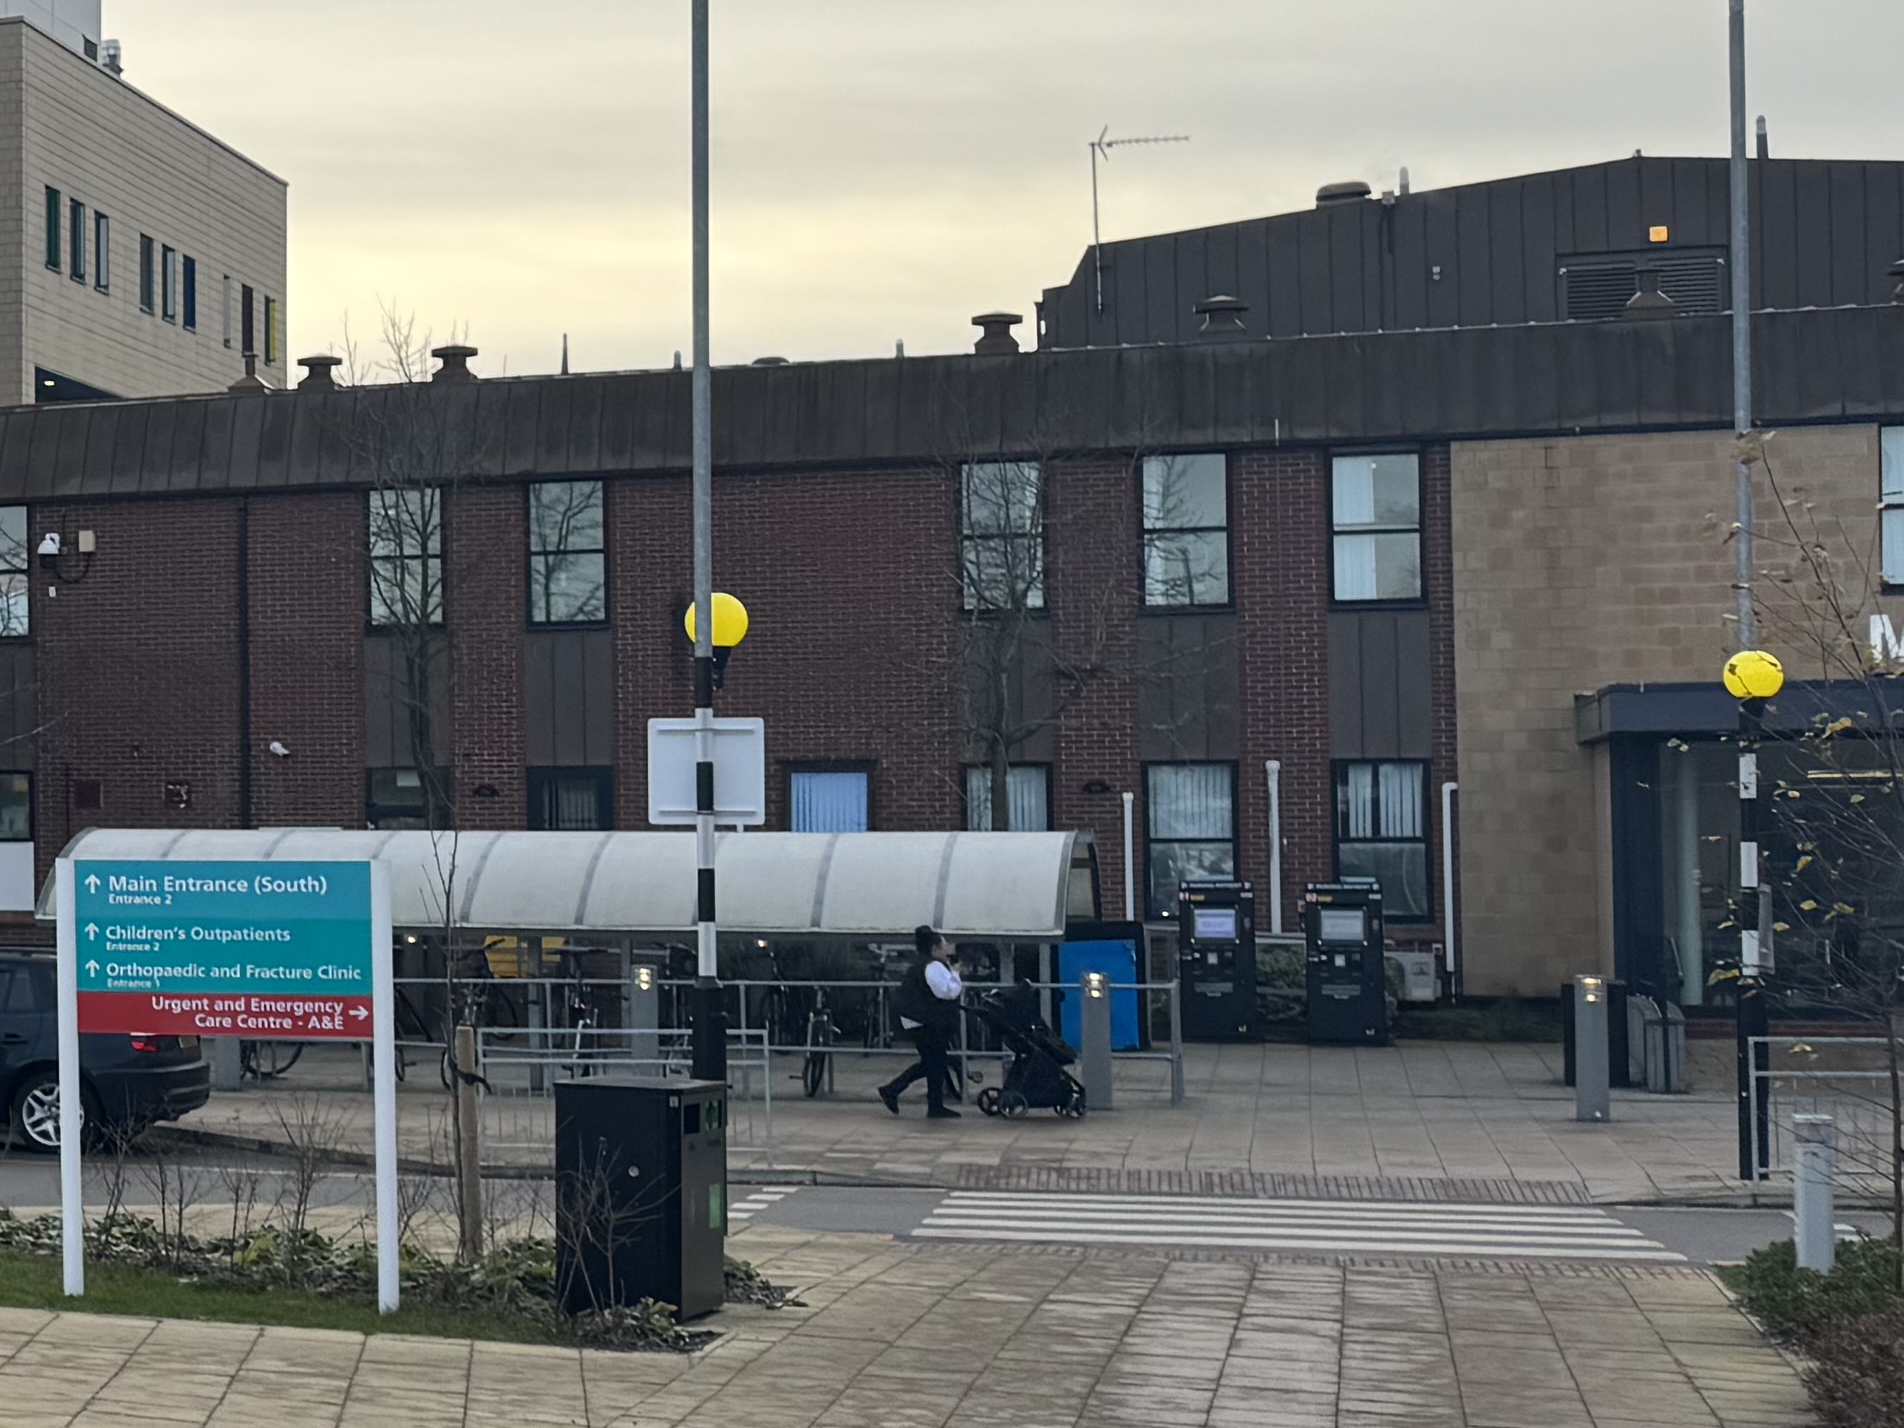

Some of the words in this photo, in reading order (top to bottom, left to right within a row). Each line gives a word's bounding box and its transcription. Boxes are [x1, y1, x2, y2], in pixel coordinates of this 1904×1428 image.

[109, 875, 157, 892] Main
[164, 875, 248, 892] Entrance
[254, 875, 327, 895] (South)
[108, 893, 161, 904] Entrance
[165, 894, 172, 905] 2
[106, 925, 186, 940] Children's
[191, 926, 291, 943] Outpatients
[106, 941, 150, 951] Entrance
[153, 942, 160, 951] 2
[106, 962, 206, 979] Orthopaedic
[210, 964, 241, 978] and
[246, 965, 312, 979] Fracture
[317, 965, 361, 980] Clinic
[107, 978, 151, 988] Entrance
[152, 996, 209, 1013] Urgent
[214, 997, 245, 1012] and
[251, 998, 343, 1016] Emergency
[195, 1014, 232, 1028] Care
[237, 1015, 293, 1029] Centre
[308, 1016, 344, 1030] A&E
